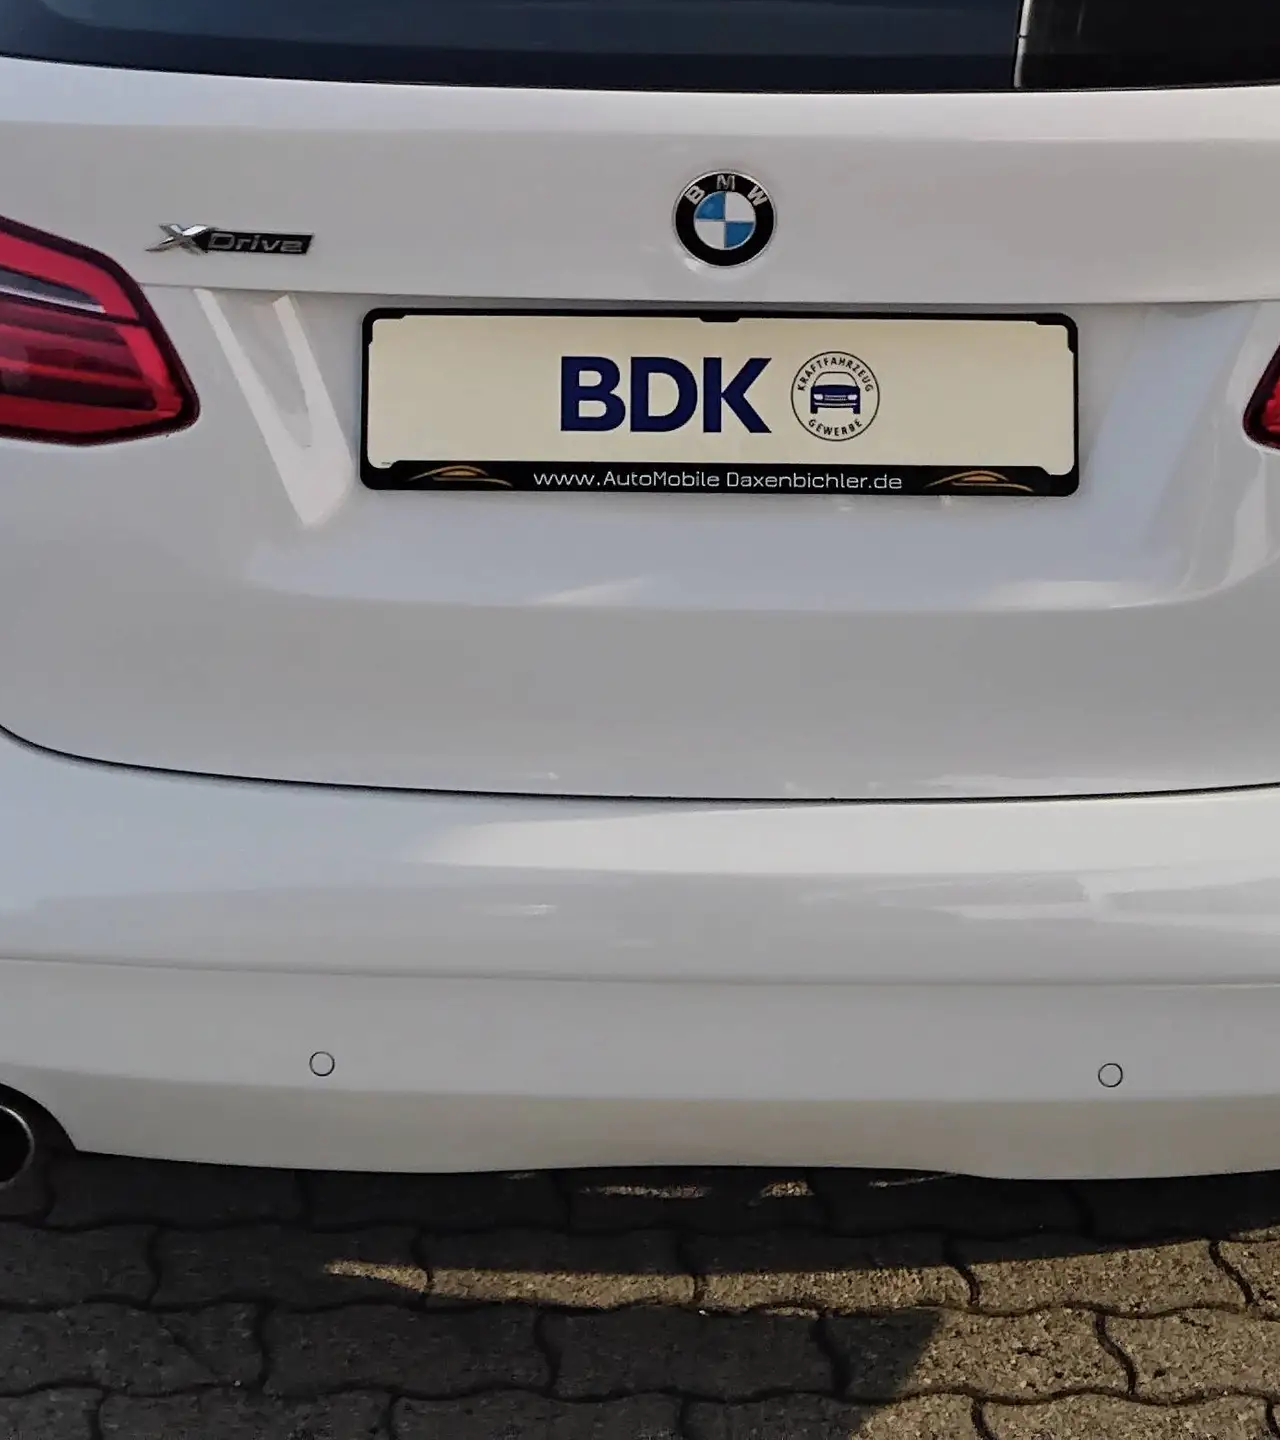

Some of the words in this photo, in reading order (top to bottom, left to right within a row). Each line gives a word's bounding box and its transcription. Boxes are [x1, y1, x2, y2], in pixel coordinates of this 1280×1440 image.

[684, 173, 768, 207] BMW
[796, 356, 875, 393] KRAFTFAHRZEUG
[559, 355, 773, 434] BDK
[808, 417, 864, 437] GEWERBE
[532, 470, 721, 488] www.AutoMobile
[725, 472, 903, 492] Daxenbichler.de
